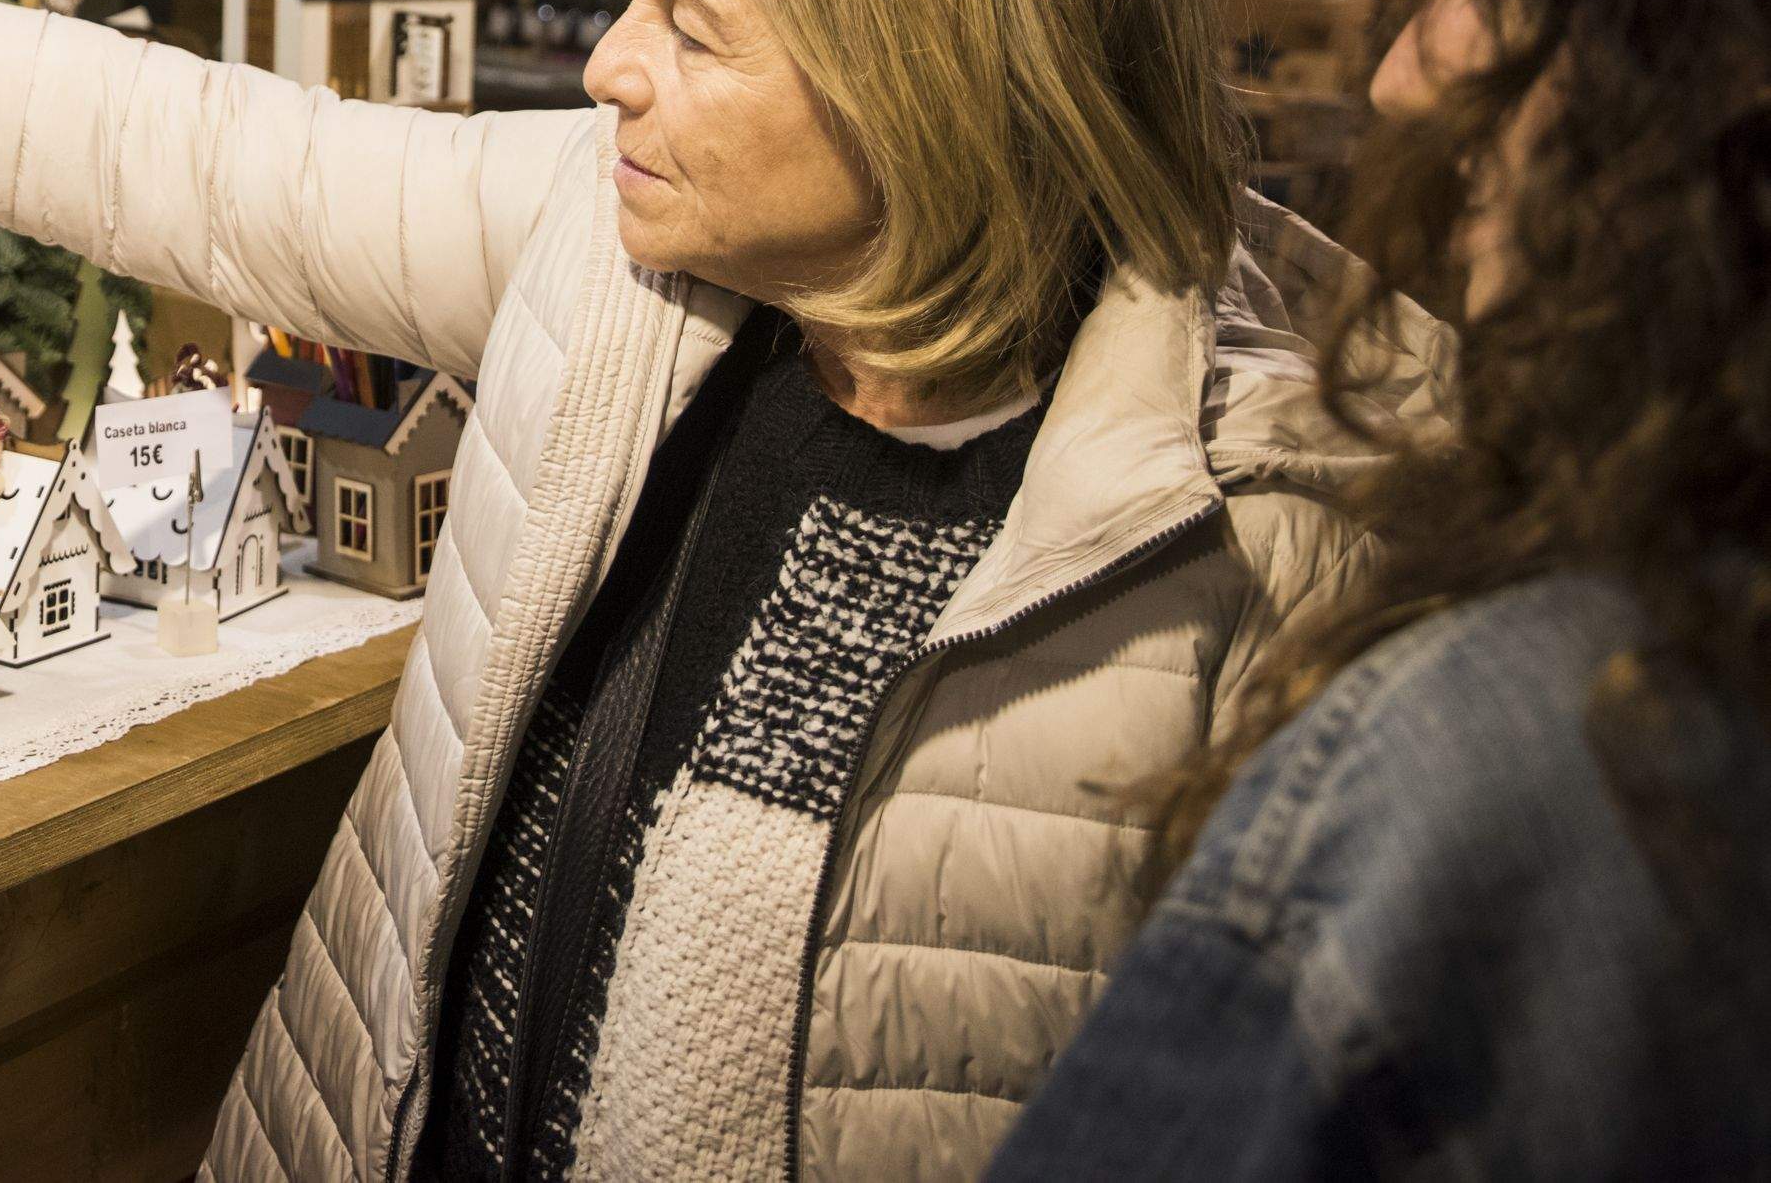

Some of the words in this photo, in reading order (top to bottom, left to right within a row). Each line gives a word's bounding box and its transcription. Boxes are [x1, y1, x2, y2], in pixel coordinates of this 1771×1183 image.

[103, 422, 145, 439] Caseta
[148, 419, 187, 434] blanca
[129, 443, 163, 467] 15€
